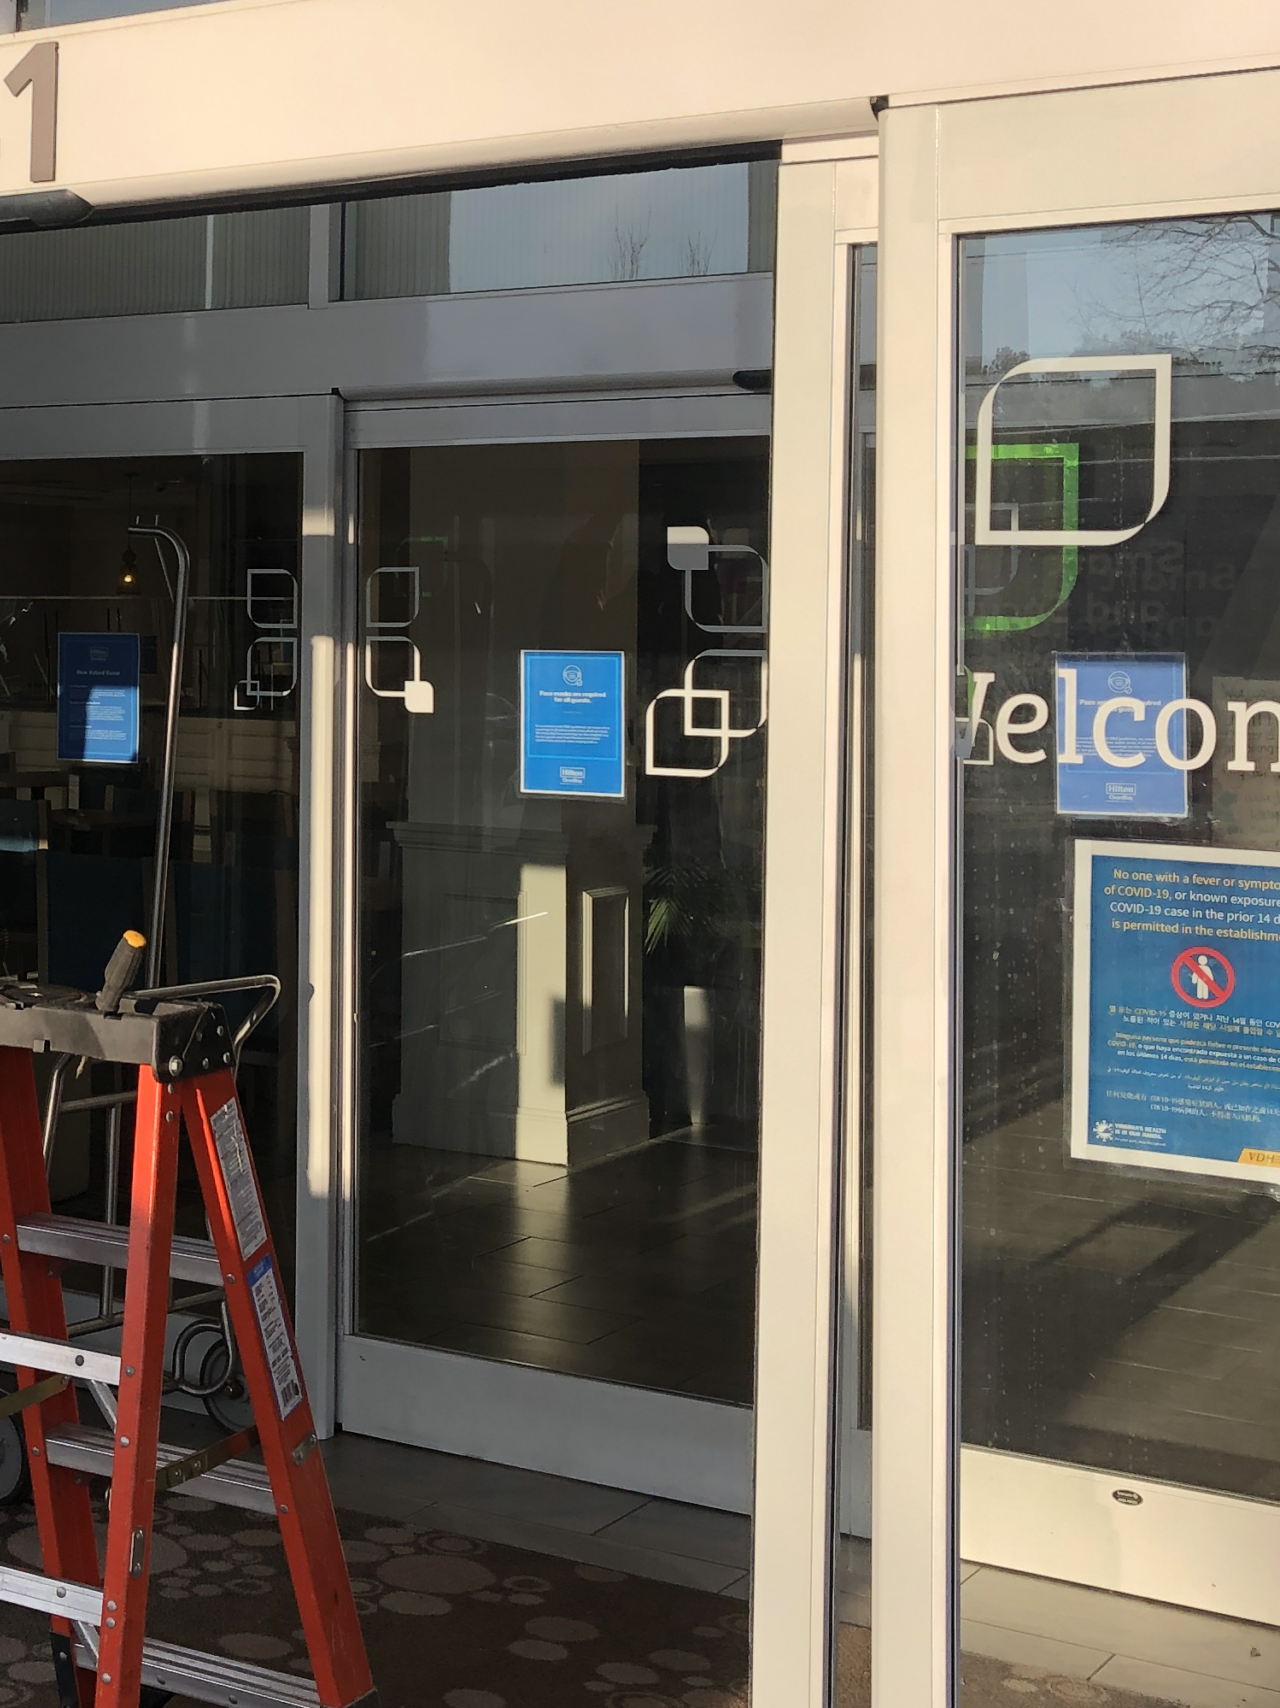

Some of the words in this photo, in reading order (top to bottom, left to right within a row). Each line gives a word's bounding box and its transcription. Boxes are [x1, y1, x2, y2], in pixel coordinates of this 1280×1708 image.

[562, 768, 583, 776] Hilton
[1114, 869, 1129, 880] No
[1132, 872, 1153, 881] one
[1156, 872, 1179, 883] with
[1182, 875, 1189, 884] a
[1192, 874, 1220, 886] fever
[1223, 878, 1234, 887] or
[1238, 879, 1280, 891] sympto
[1104, 884, 1116, 895] of
[1118, 886, 1172, 901] COVID-19,
[1174, 891, 1187, 900] or
[1190, 890, 1228, 904] known
[1110, 902, 1162, 915] COVID-19
[1164, 908, 1190, 917] case
[1192, 909, 1203, 918] in
[1206, 909, 1224, 920] the
[1226, 911, 1255, 924] prior
[1258, 913, 1271, 923] 14
[1111, 918, 1120, 929] is
[1123, 920, 1179, 934] permitted
[1182, 924, 1192, 934] in
[1195, 924, 1213, 936] the
[1216, 927, 1280, 942] establishm
[1134, 1008, 1166, 1016] COVID-19
[1156, 1044, 1171, 1052] haya
[1172, 1047, 1208, 1055] encontrado
[1209, 1050, 1237, 1058] expuesta
[1144, 1126, 1167, 1134] HEALTH
[1249, 1152, 1275, 1163] VDH
